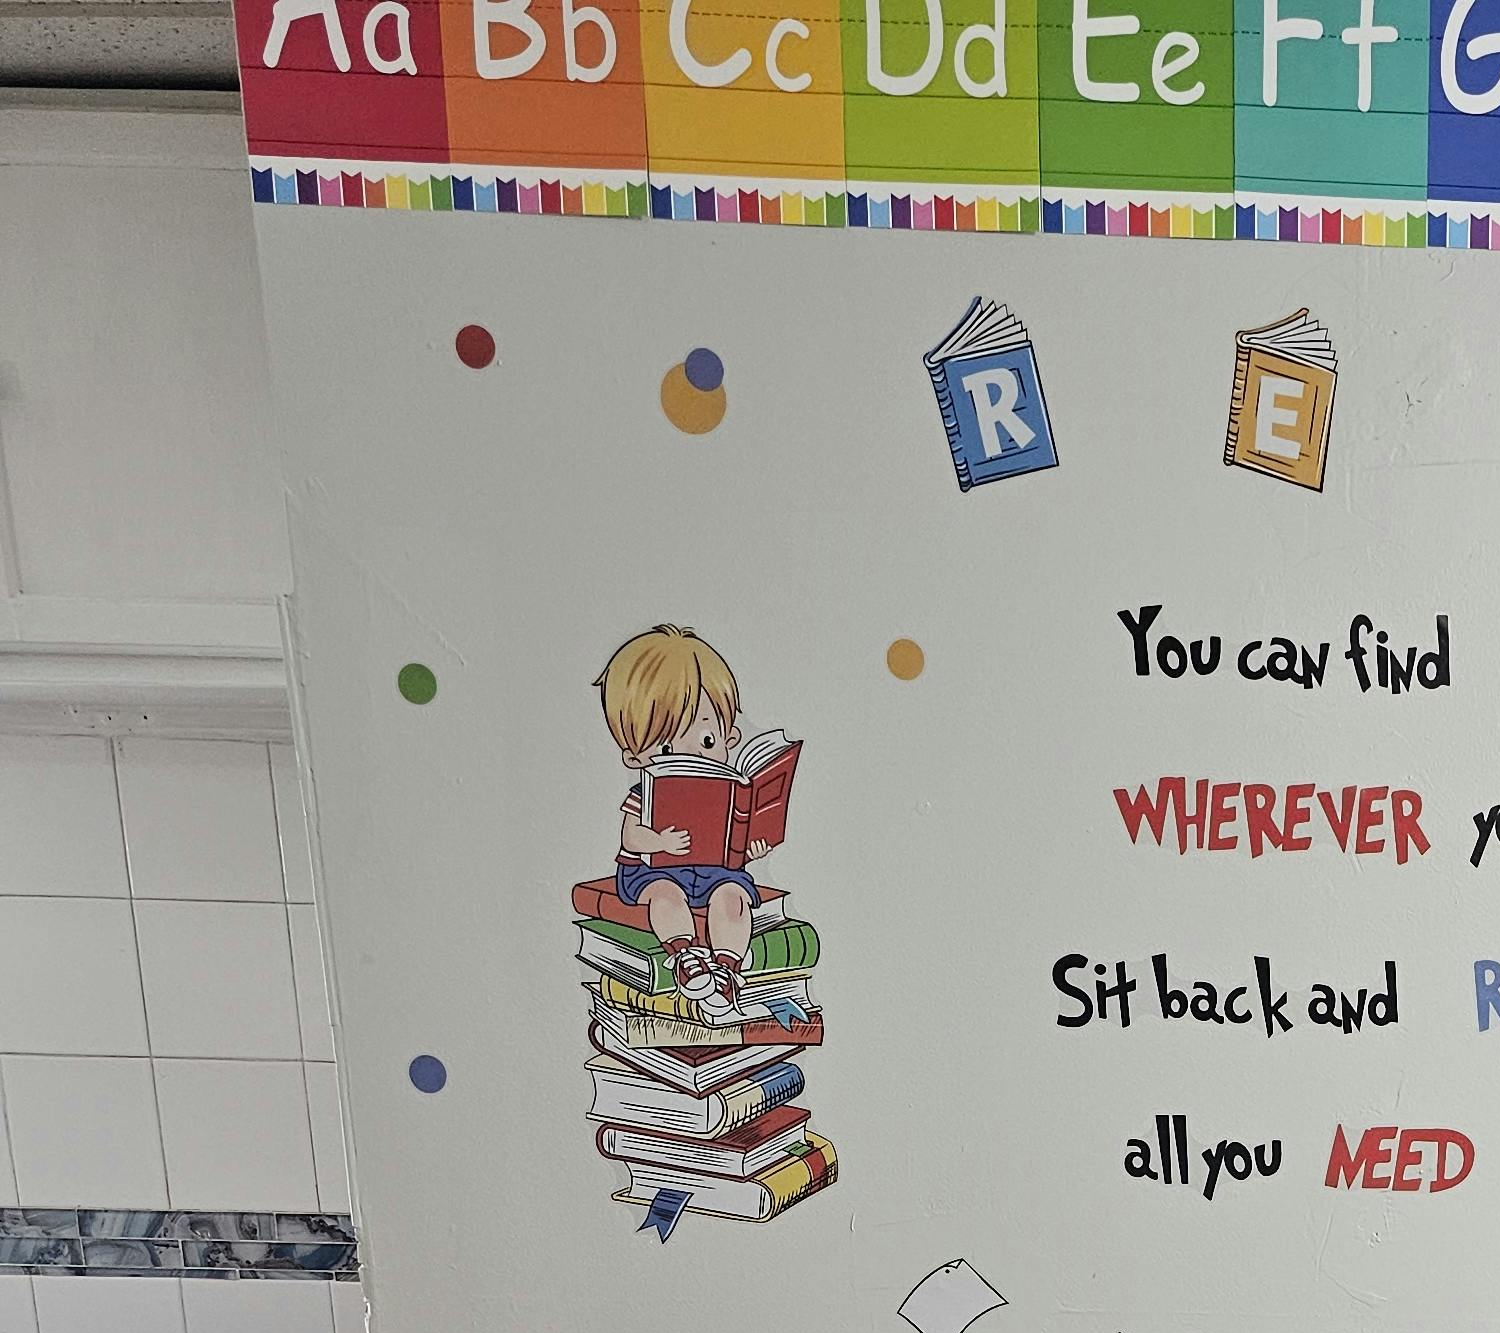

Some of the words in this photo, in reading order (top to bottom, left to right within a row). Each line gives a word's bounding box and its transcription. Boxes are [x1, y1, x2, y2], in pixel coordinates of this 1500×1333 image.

[964, 365, 1036, 460] R
[1254, 376, 1304, 460] E
[1117, 604, 1222, 678] You
[1237, 636, 1331, 690] can
[1345, 615, 1450, 694] find
[1112, 776, 1431, 866] WHEREVER
[1051, 954, 1137, 1030] Sit
[1152, 954, 1294, 1038] back
[1308, 961, 1399, 1034] and
[1124, 1114, 1189, 1186] all
[1200, 1137, 1283, 1201] you
[1323, 1123, 1475, 1193] NEED
